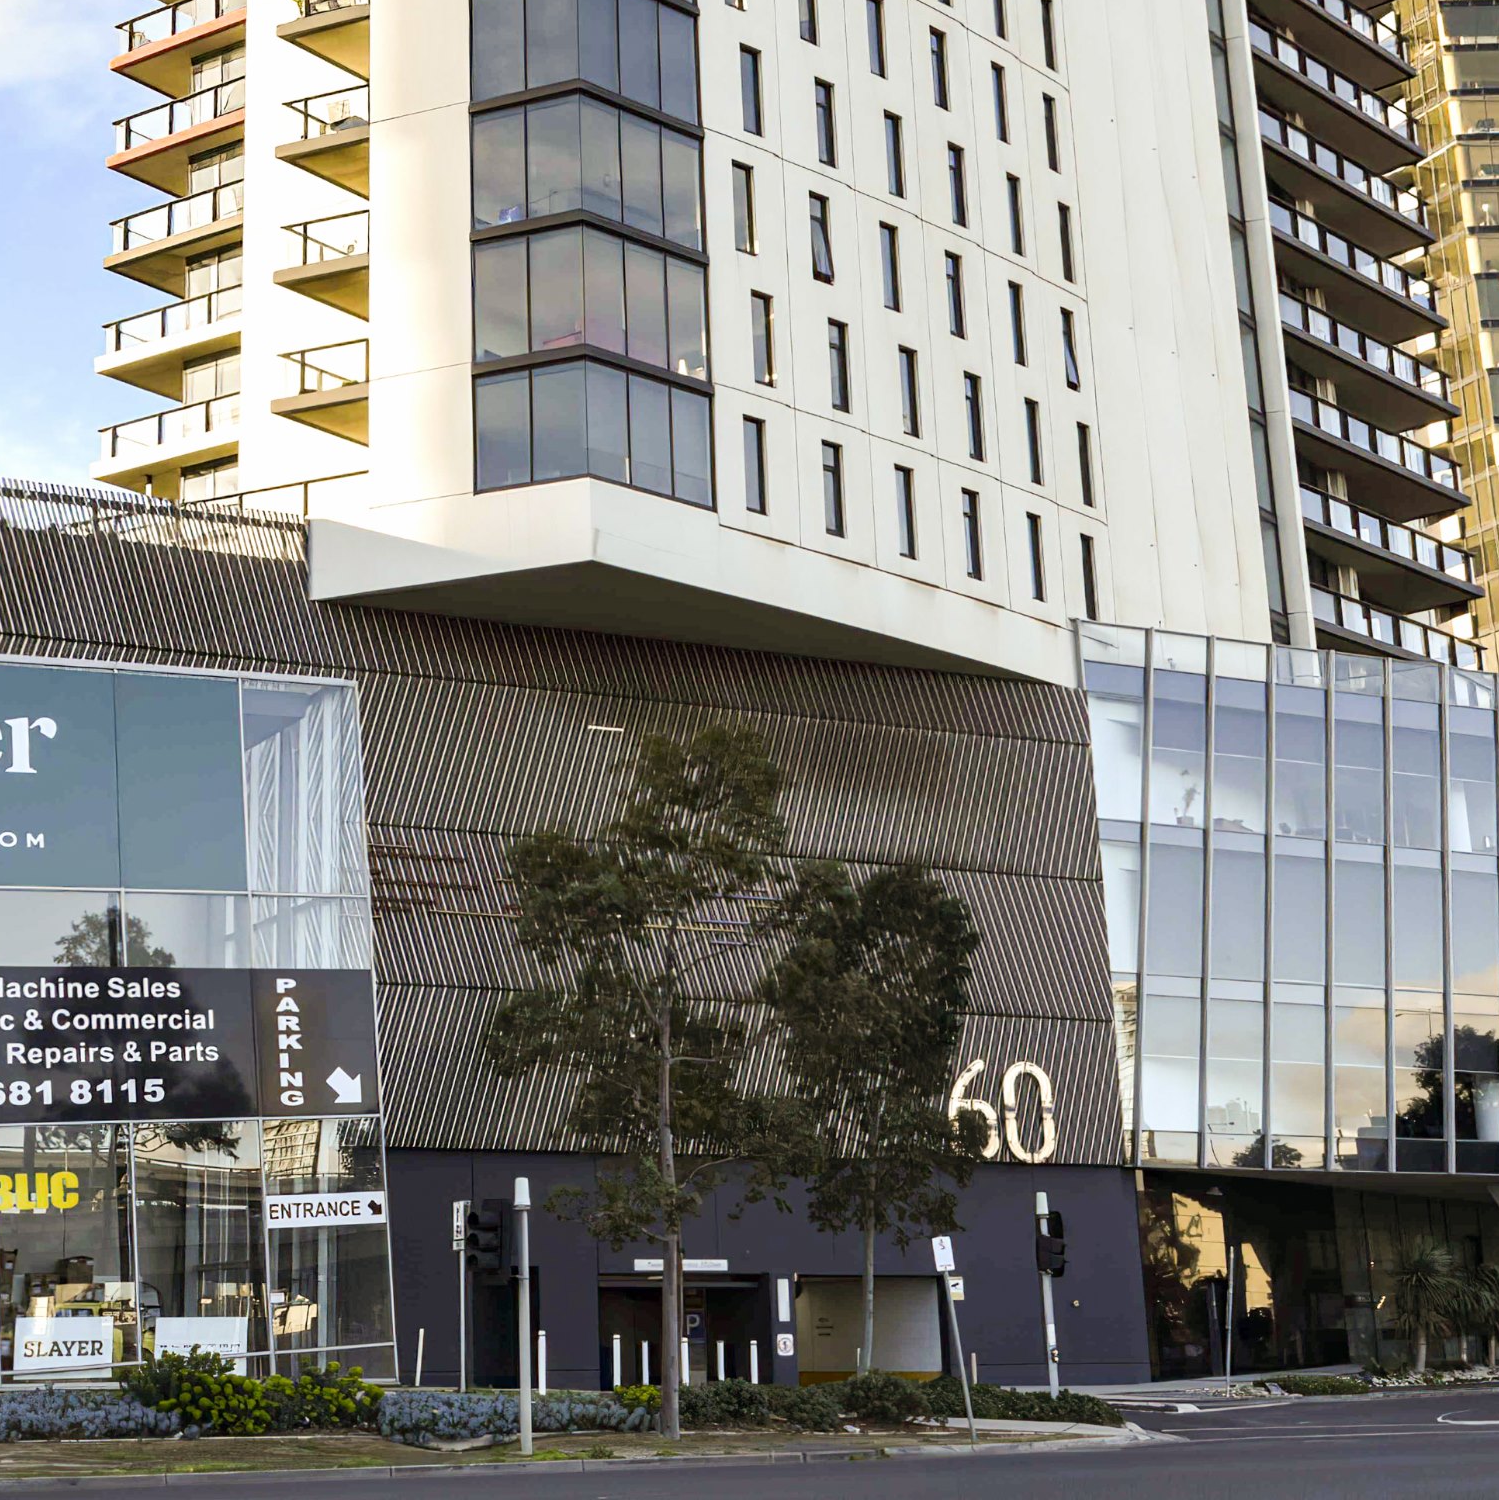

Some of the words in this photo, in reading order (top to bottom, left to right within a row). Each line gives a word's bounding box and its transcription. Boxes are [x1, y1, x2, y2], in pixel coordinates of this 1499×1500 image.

[107, 977, 181, 999] Sales
[23, 1009, 44, 1031] &
[52, 1009, 215, 1031] Commercial
[275, 978, 304, 1106] PARKING
[6, 1042, 114, 1069] Repairs
[122, 1041, 143, 1063] &
[150, 1042, 220, 1063] Parts
[69, 1078, 166, 1105] 8115
[948, 1059, 1056, 1164] 60
[269, 1200, 361, 1221] ENTRANCE
[686, 1314, 700, 1335] P
[23, 1340, 103, 1357] SLAYER
